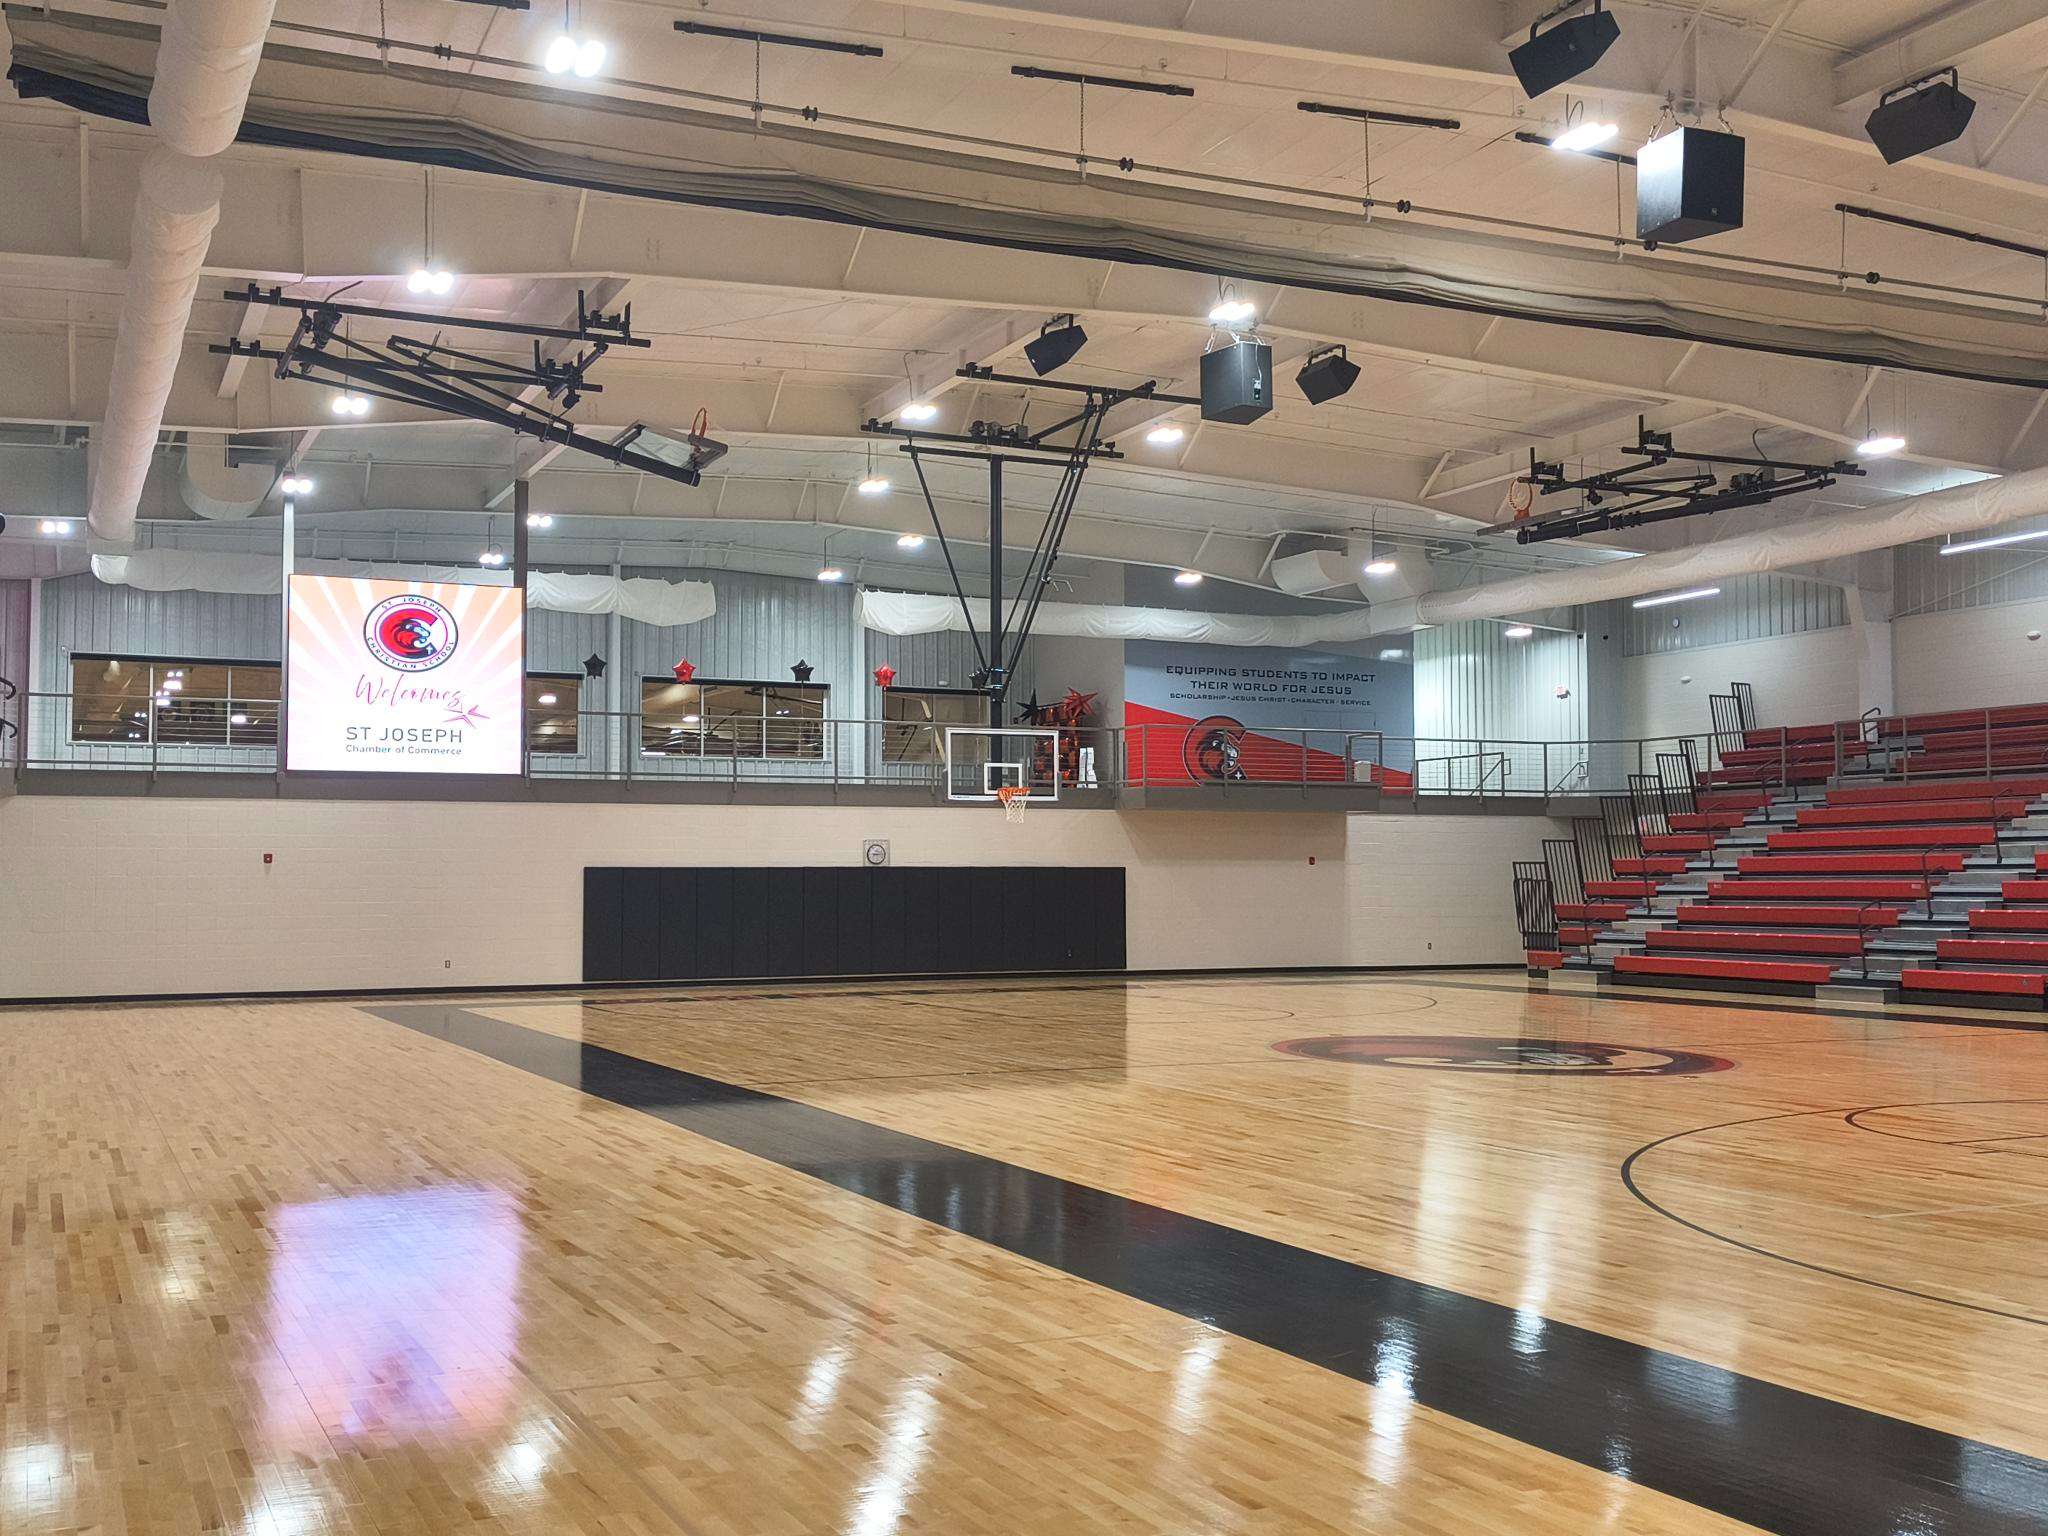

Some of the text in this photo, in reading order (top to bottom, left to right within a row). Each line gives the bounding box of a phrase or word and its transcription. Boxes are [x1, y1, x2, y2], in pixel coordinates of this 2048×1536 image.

[403, 597, 442, 612] JOSEPH
[367, 636, 454, 669] CHRISTIAN SCHOOL
[1166, 665, 1376, 682] EQUIPPING STUDENTS TO IMPACT
[355, 673, 462, 708] Welcomes
[1190, 680, 1352, 695] THEIR WORLD FOR JESUS
[1169, 692, 1226, 701] SCHOLARSHIP
[1291, 697, 1335, 705] CHARACTER
[346, 726, 462, 743] ST JOSEPH
[345, 744, 462, 756] Chamber of Commerce
